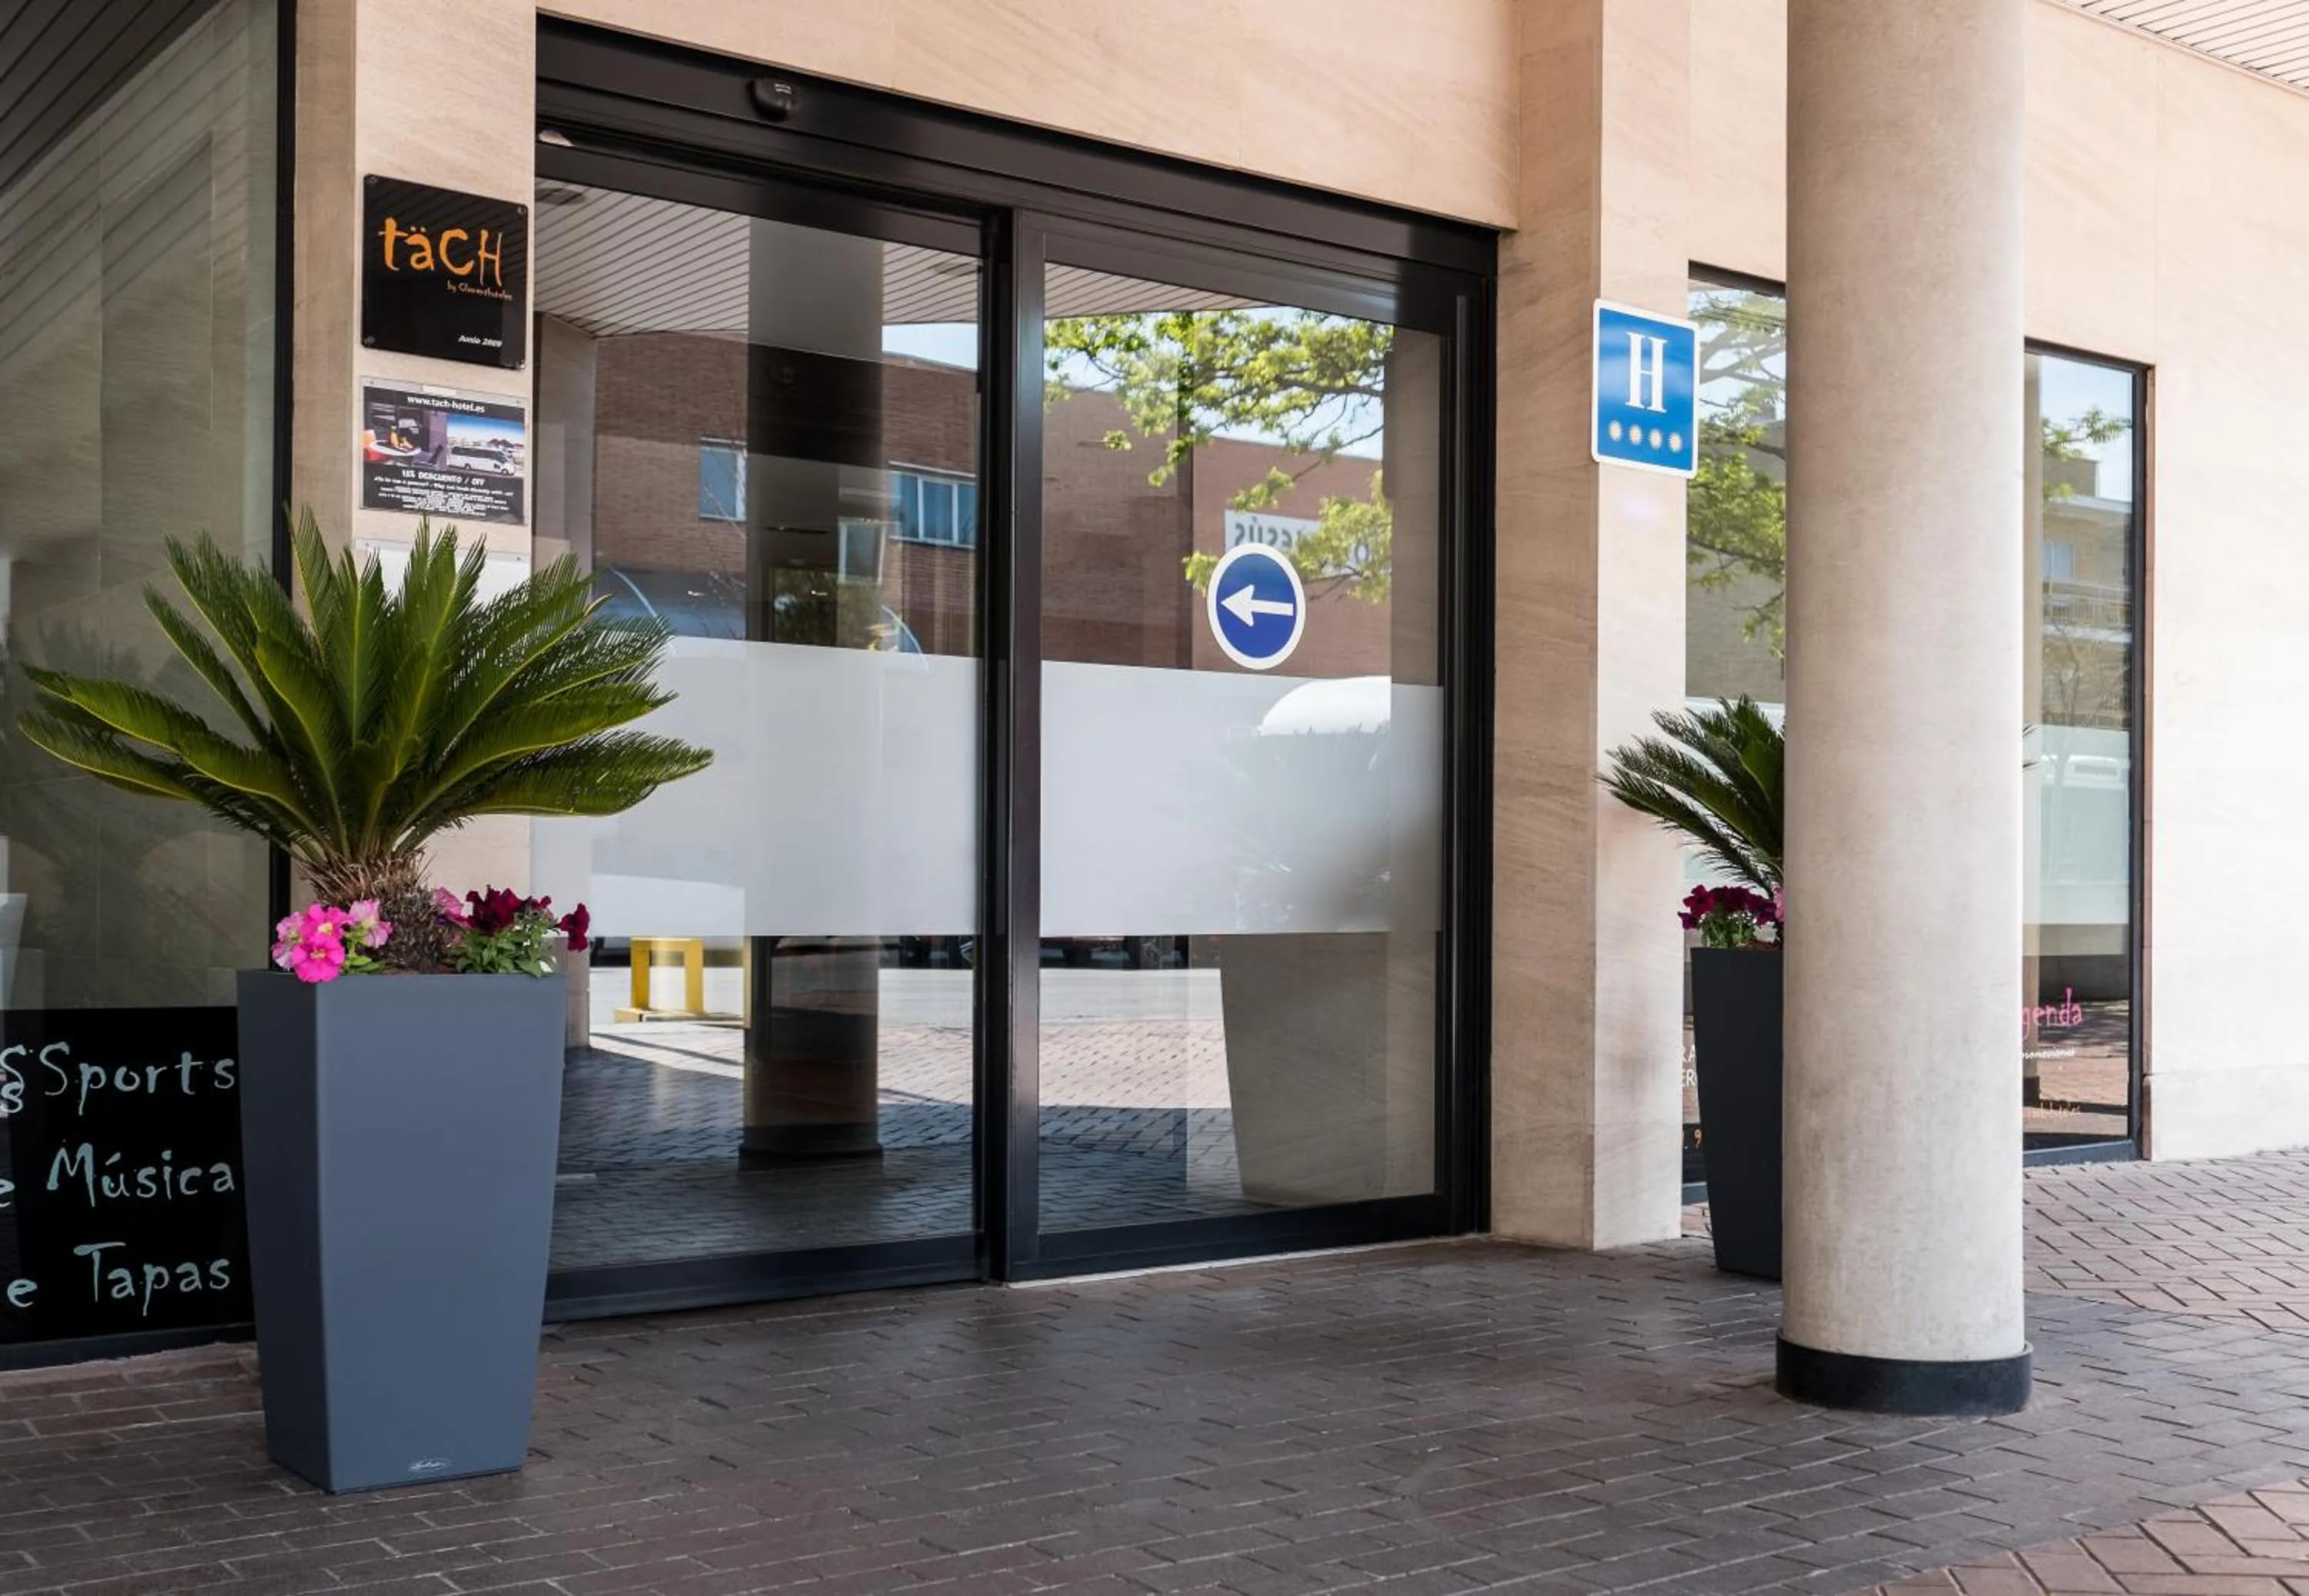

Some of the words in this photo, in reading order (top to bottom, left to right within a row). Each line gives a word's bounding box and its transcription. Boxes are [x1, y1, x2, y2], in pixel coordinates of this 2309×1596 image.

[459, 335, 481, 344] Junio
[1626, 332, 1668, 413] H
[418, 472, 463, 484] DESCUENTO
[39, 1041, 236, 1116] Sports
[47, 1142, 236, 1207] Música
[73, 1241, 231, 1317] Tapas
